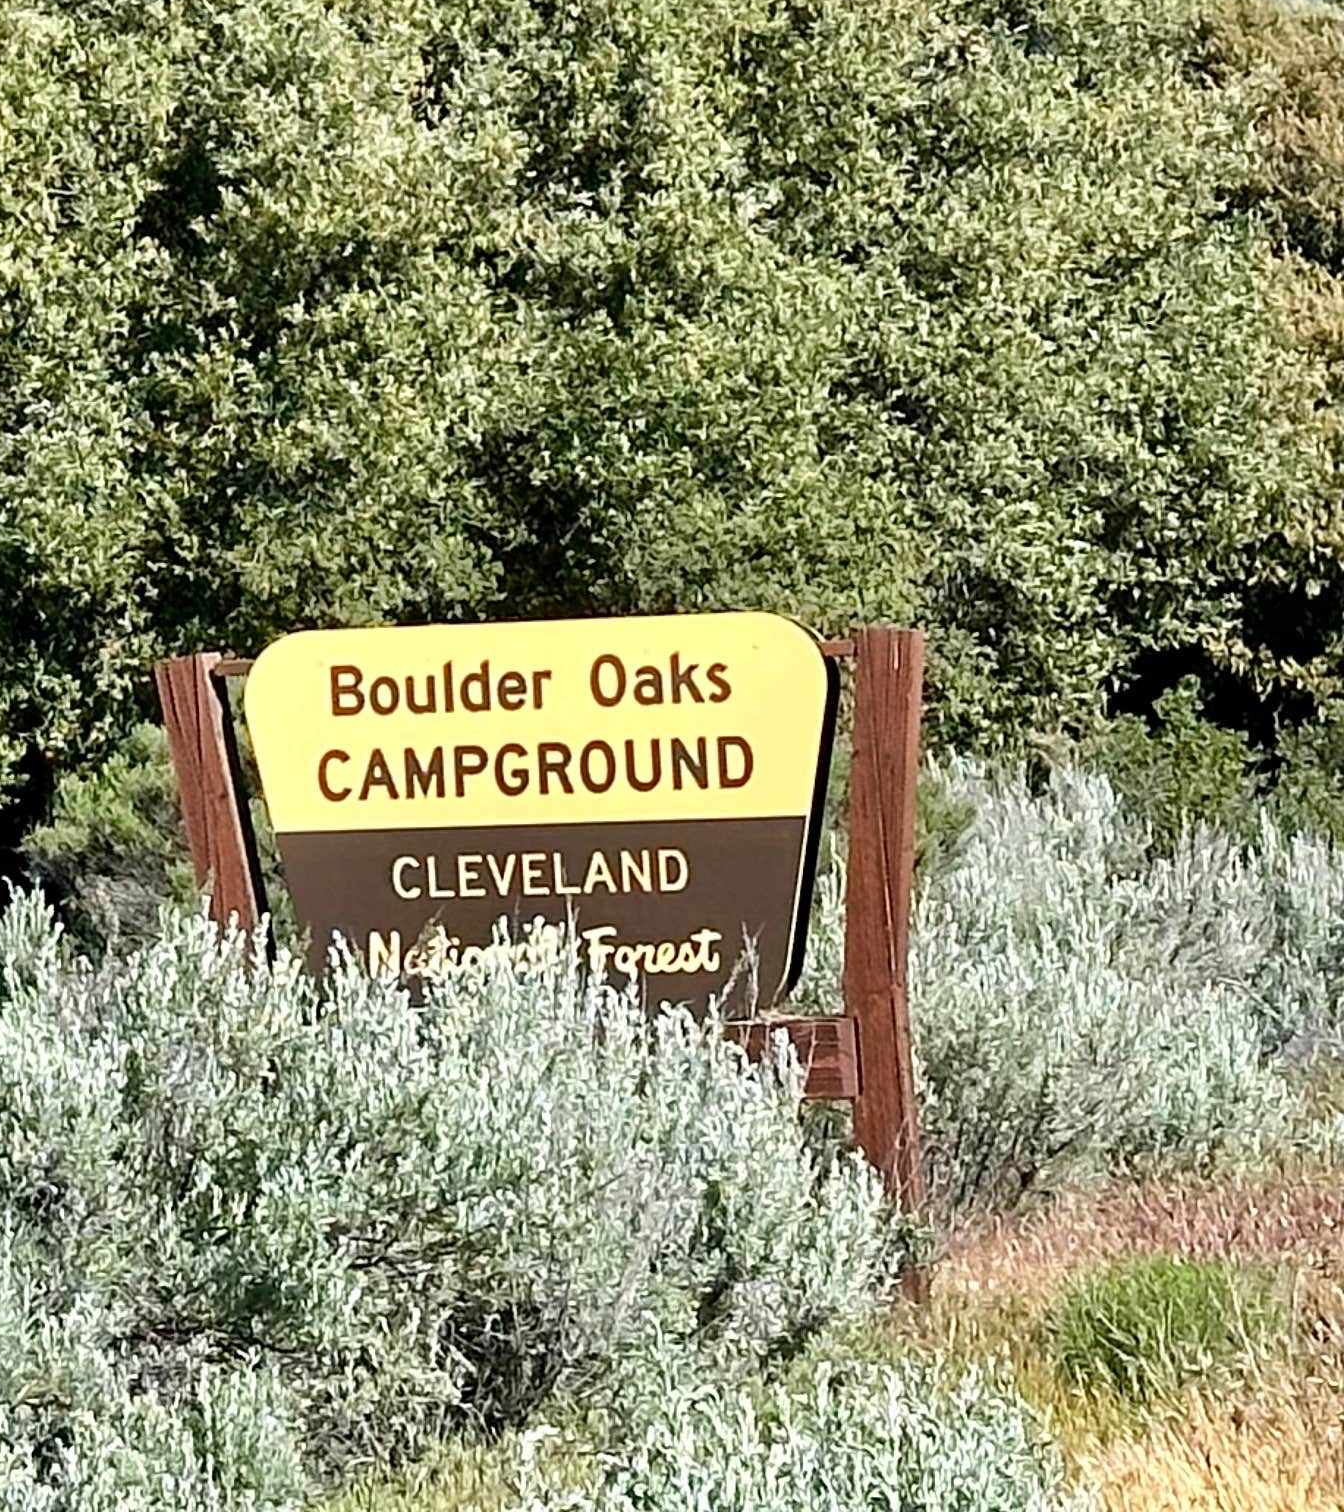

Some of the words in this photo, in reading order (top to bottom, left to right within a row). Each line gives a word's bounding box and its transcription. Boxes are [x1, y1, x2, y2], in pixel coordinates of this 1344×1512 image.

[330, 660, 552, 717] Boulder
[588, 650, 732, 708] Oaks
[317, 735, 755, 803] CAMPGROUND
[392, 848, 690, 900] CLEVELAND
[582, 925, 723, 976] Forest
